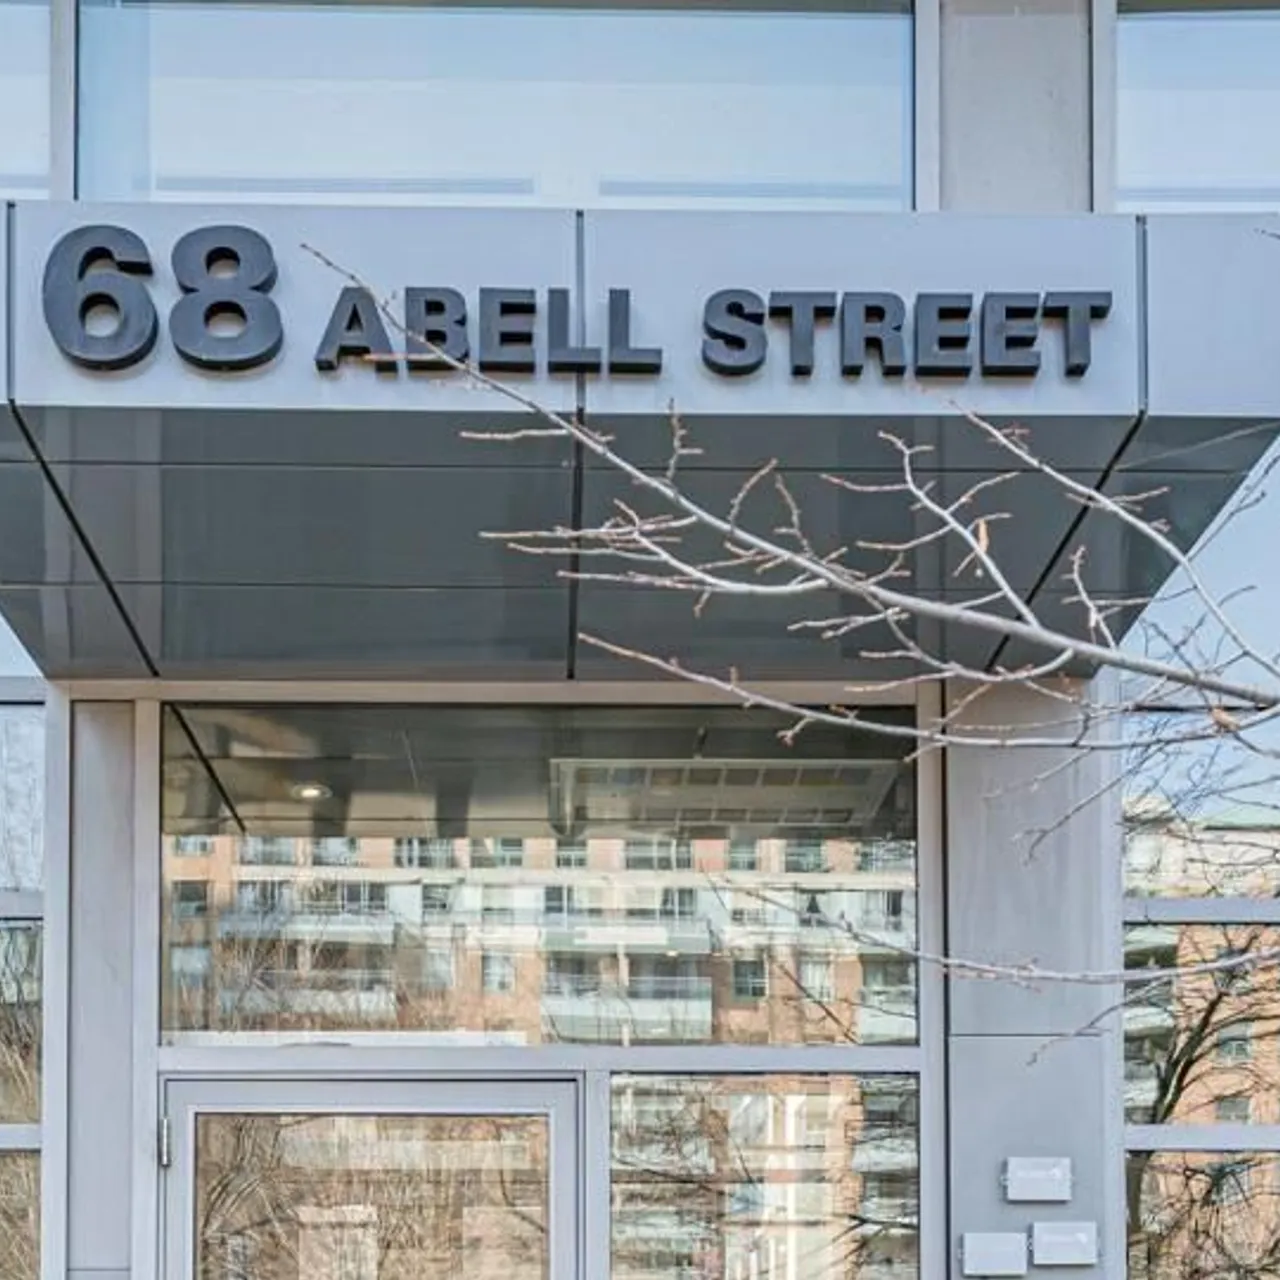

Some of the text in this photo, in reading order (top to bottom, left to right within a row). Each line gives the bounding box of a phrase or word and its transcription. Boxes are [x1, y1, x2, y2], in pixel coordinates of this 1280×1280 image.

[42, 224, 1113, 377] 68 ABELL STREET
